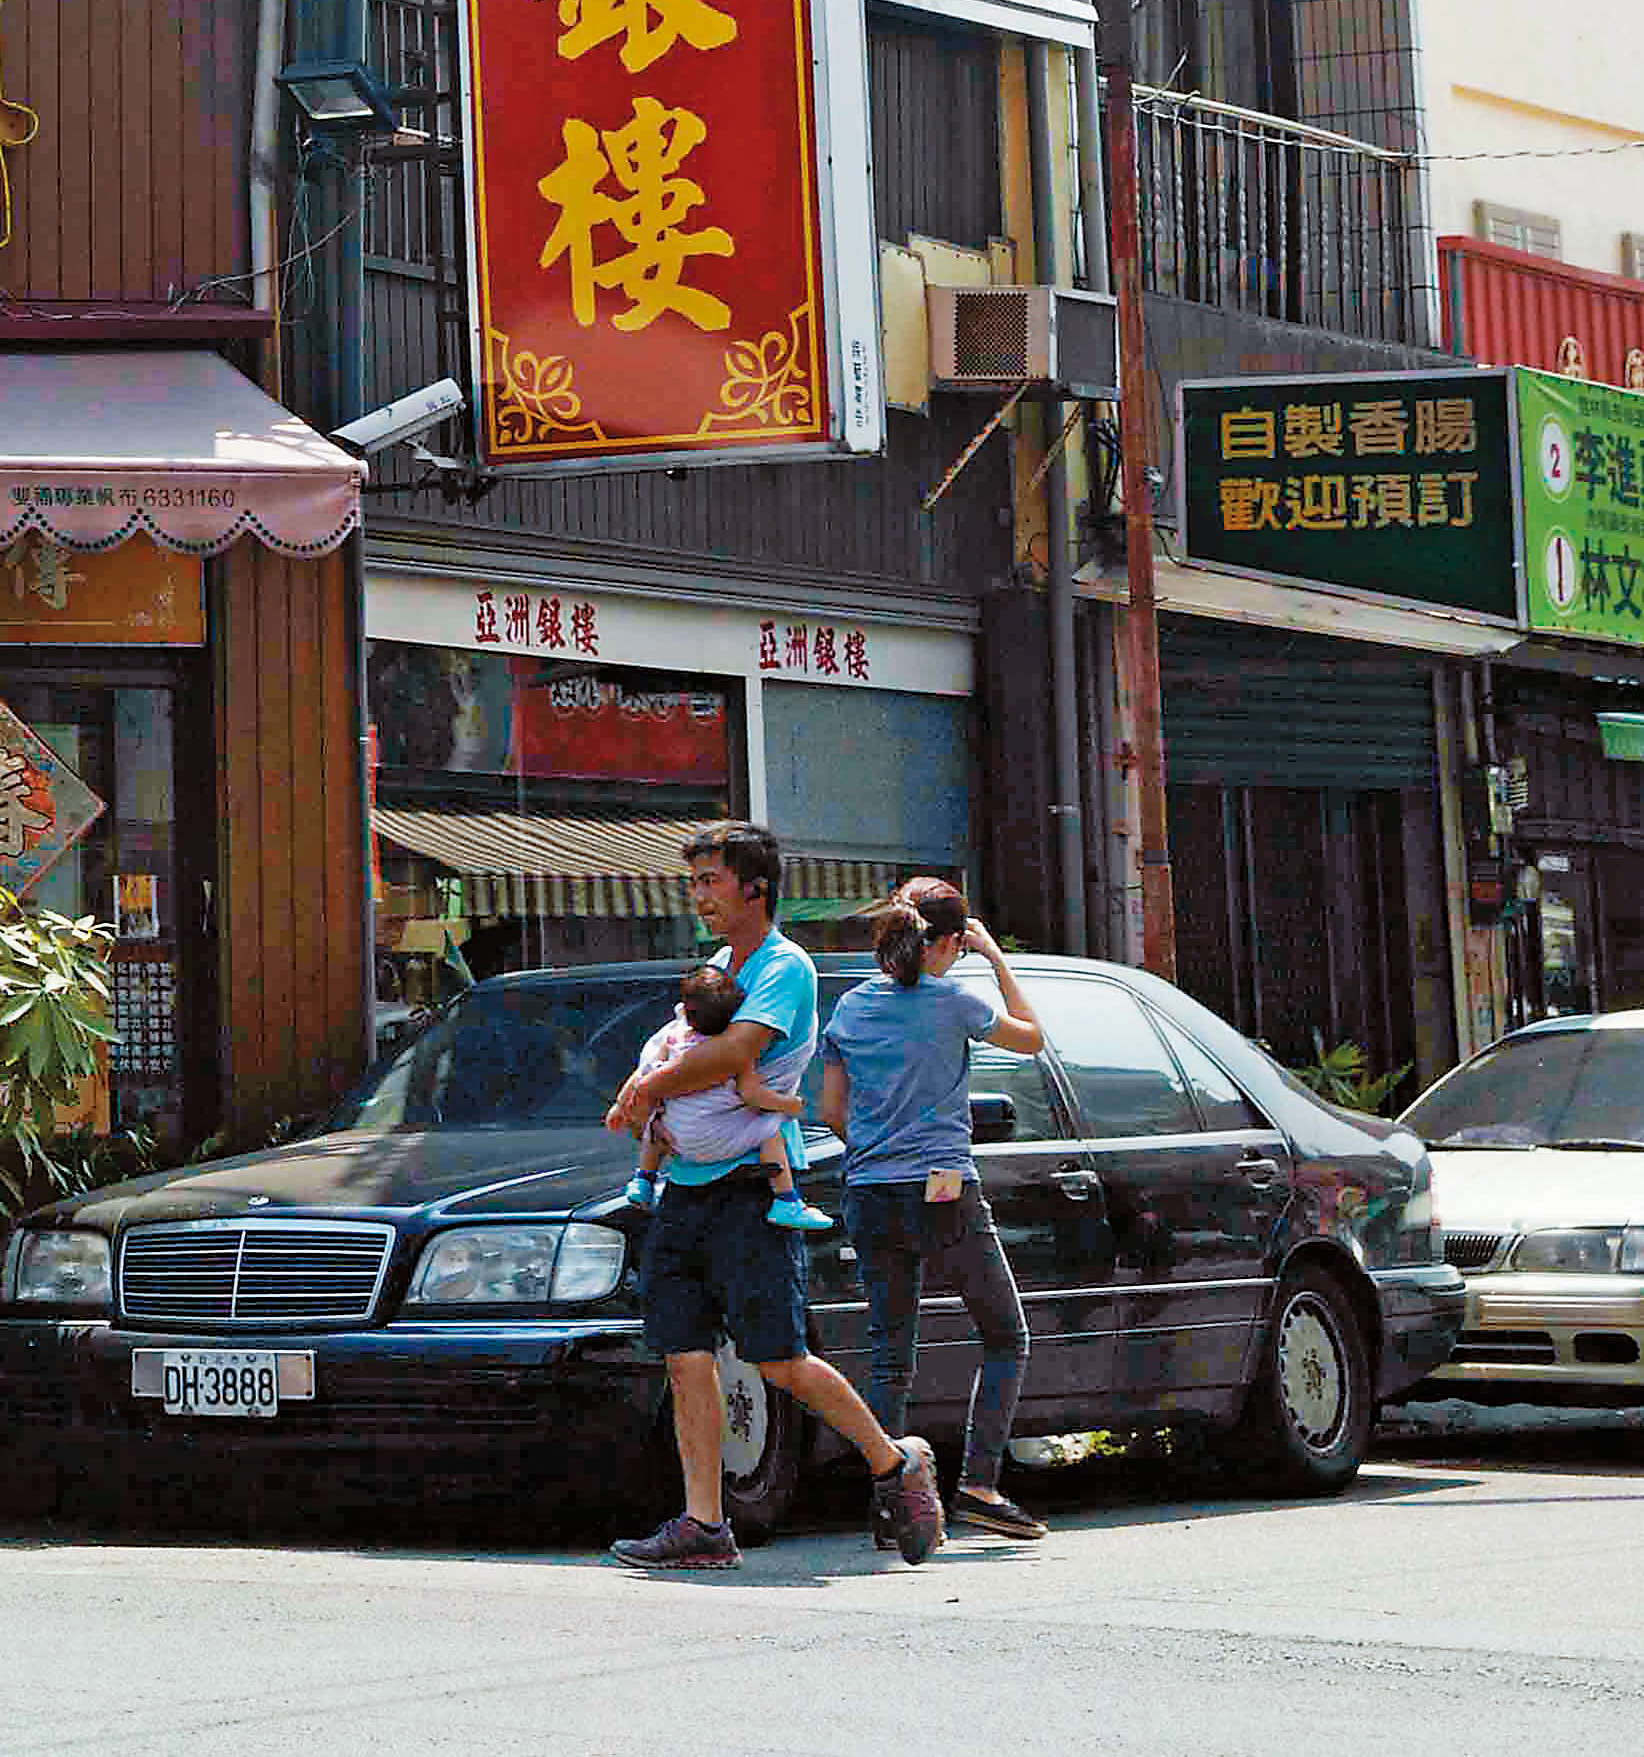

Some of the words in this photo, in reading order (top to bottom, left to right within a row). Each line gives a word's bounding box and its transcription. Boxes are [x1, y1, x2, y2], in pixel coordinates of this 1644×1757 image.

[1219, 396, 1478, 460] 自製香腸
[1574, 426, 1644, 509] 李進
[1218, 469, 1480, 531] 歡迎預訂
[474, 590, 600, 657] 亞洲銀樓
[759, 619, 871, 681] 亞洲銀樓
